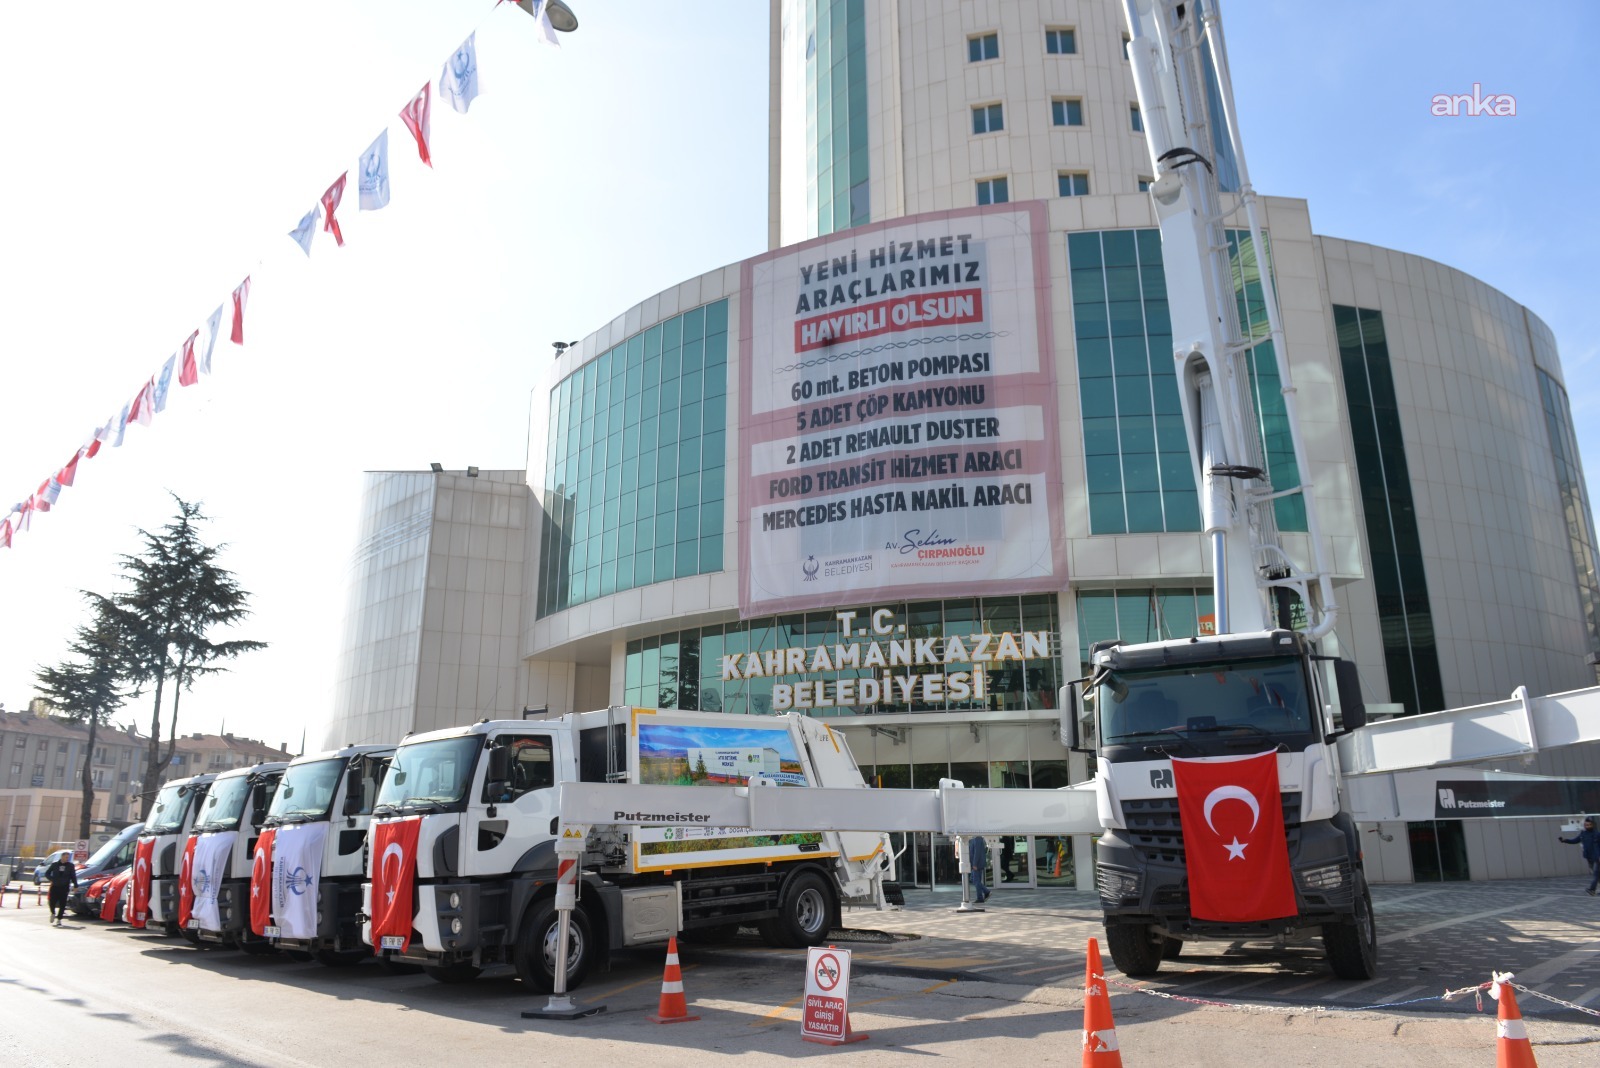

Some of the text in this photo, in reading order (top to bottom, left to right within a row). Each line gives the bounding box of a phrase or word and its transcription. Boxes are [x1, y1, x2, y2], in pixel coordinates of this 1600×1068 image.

[800, 234, 972, 285] YENİ HİZMET
[795, 261, 980, 315] ARAÇLARIMIZ
[801, 294, 974, 346] HAYIRLI OLSUN
[791, 352, 989, 401] 60 mt. BETON POMPASI
[797, 384, 985, 431] 5 ADET ÇÖP KAMYONU
[786, 417, 1000, 464] 2 ADET RENAULT DUSTER
[769, 448, 1022, 499] FORD TRANSİT HİZMET ARACI
[763, 483, 1032, 532] MERCEDES HASTA NAKİL ARACI
[825, 554, 872, 567] KAHRAMANKAZAN
[900, 529, 957, 554] Selim
[917, 544, 985, 561] ÇIRPANOĞLU
[824, 563, 873, 577] BELEDİYESİ
[721, 629, 1050, 682] KAHRAMANKAZAN
[772, 664, 985, 711] BELEDİYESİ
[613, 811, 710, 823] Putzmeister
[1457, 800, 1505, 808] Putzmeister
[808, 998, 843, 1012] SİVİL ARAÇ
[808, 1022, 839, 1033] YASAKTIR
[814, 1010, 834, 1022] GİRİŞİ
